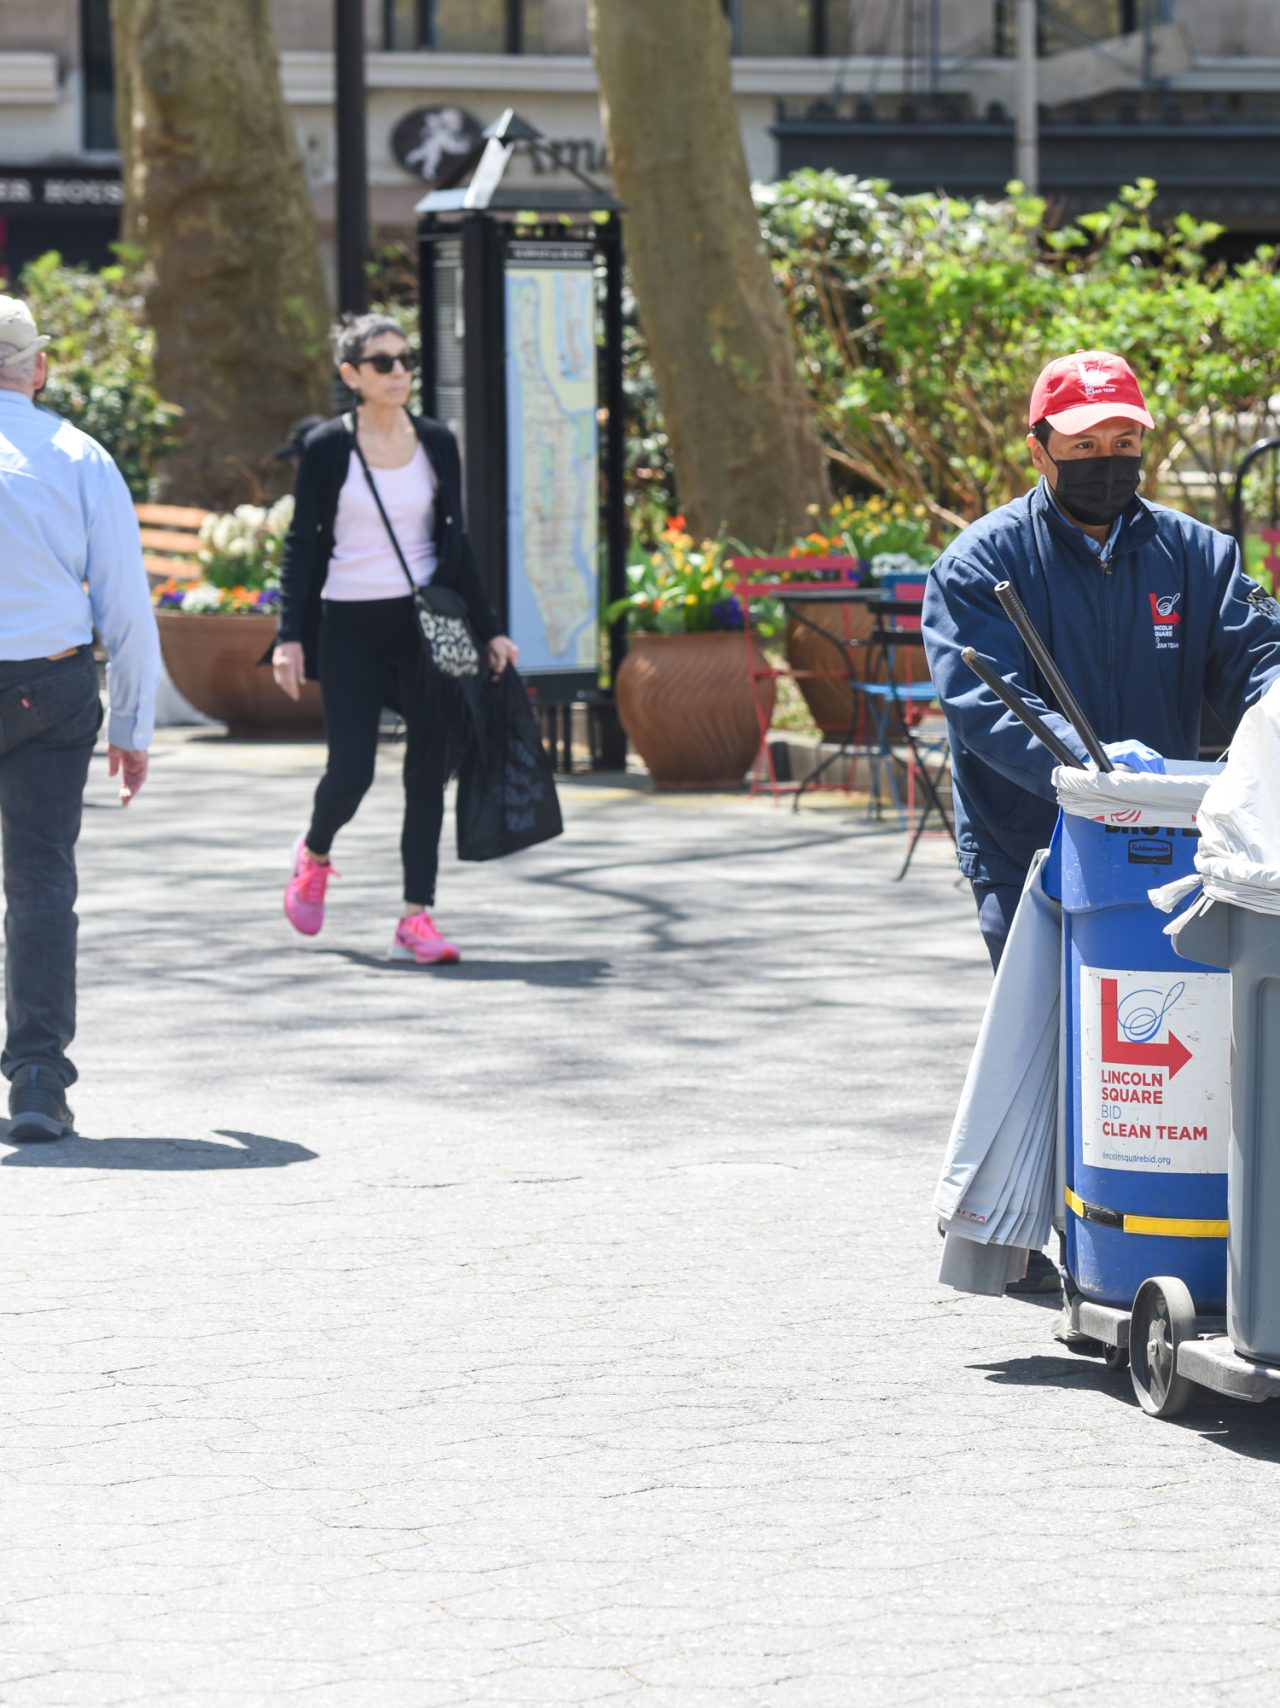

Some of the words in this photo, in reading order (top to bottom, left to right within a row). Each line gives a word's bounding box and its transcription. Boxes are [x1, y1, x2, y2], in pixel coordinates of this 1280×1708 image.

[1101, 1070, 1163, 1087] LINCOLN
[1102, 1087, 1163, 1104] SQUARE
[1101, 1104, 1121, 1119] BID
[1102, 1122, 1151, 1139] CLEAN
[1156, 1126, 1208, 1140] TEAM
[1103, 1152, 1171, 1165] lincolnsquarebid.org
